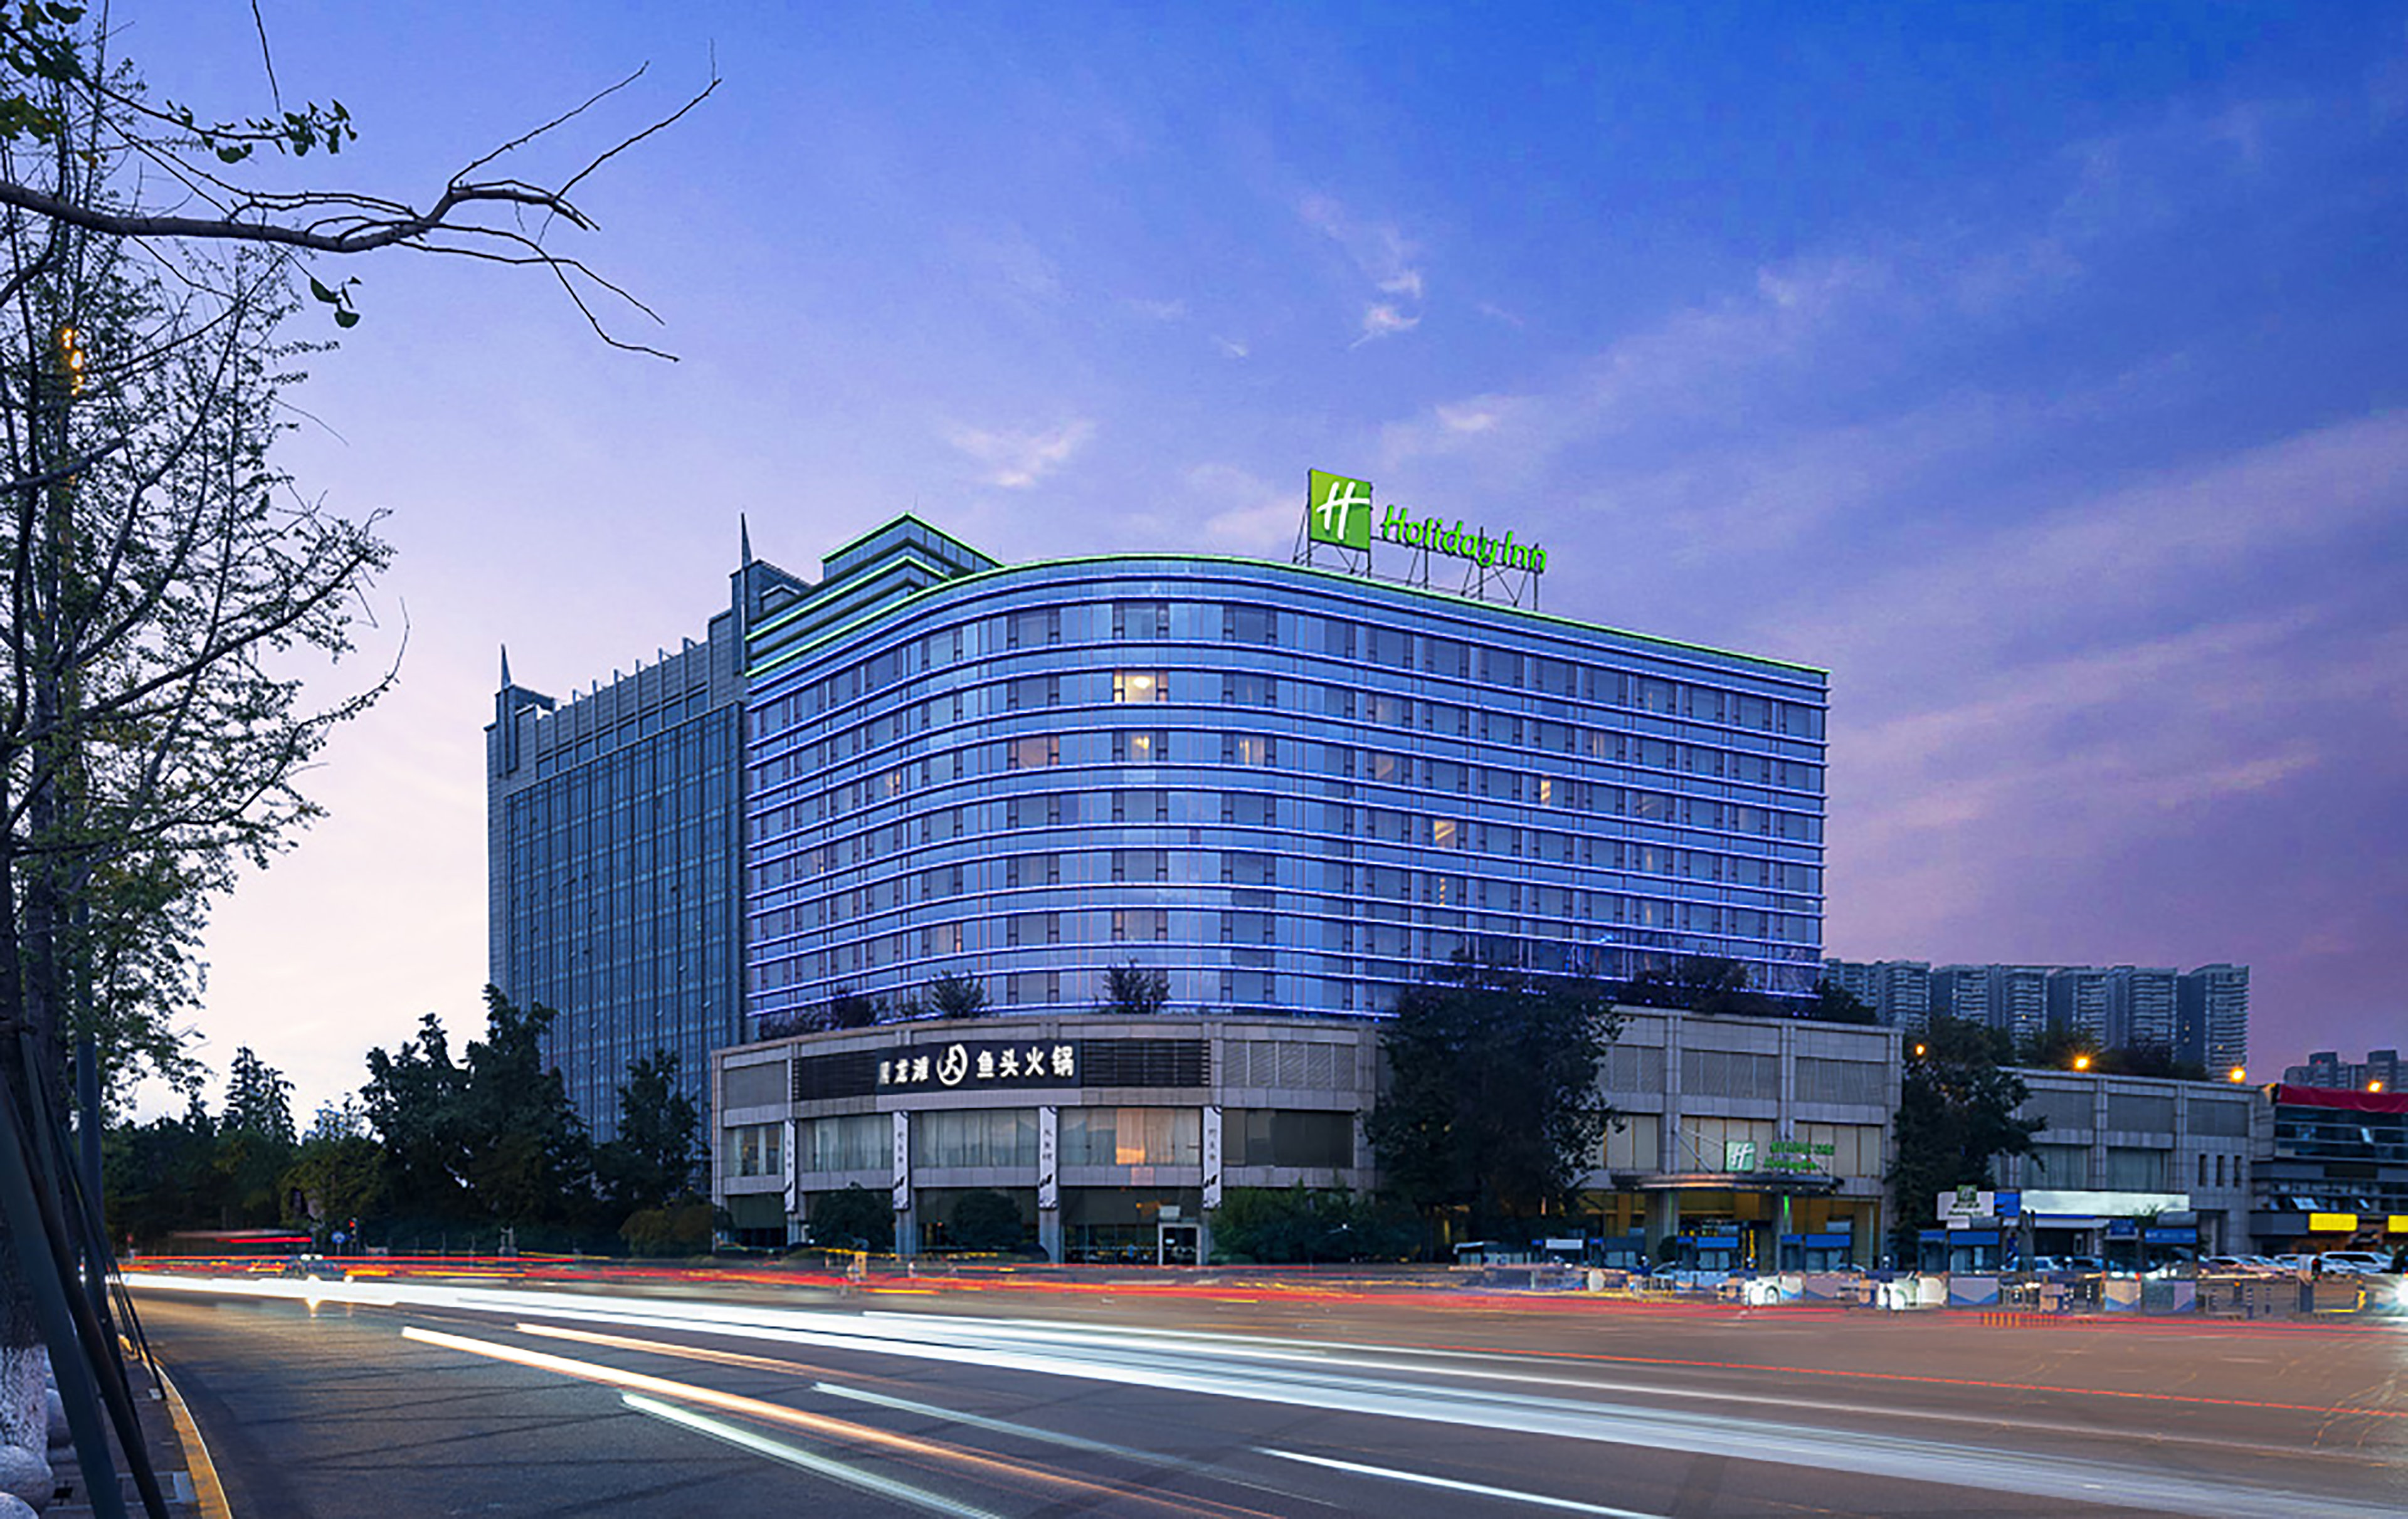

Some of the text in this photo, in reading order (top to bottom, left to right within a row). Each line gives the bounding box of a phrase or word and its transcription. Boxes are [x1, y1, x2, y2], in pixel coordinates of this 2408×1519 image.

[1382, 505, 1548, 572] Holiday Inn
[976, 1044, 1075, 1078] 鱼头火锅
